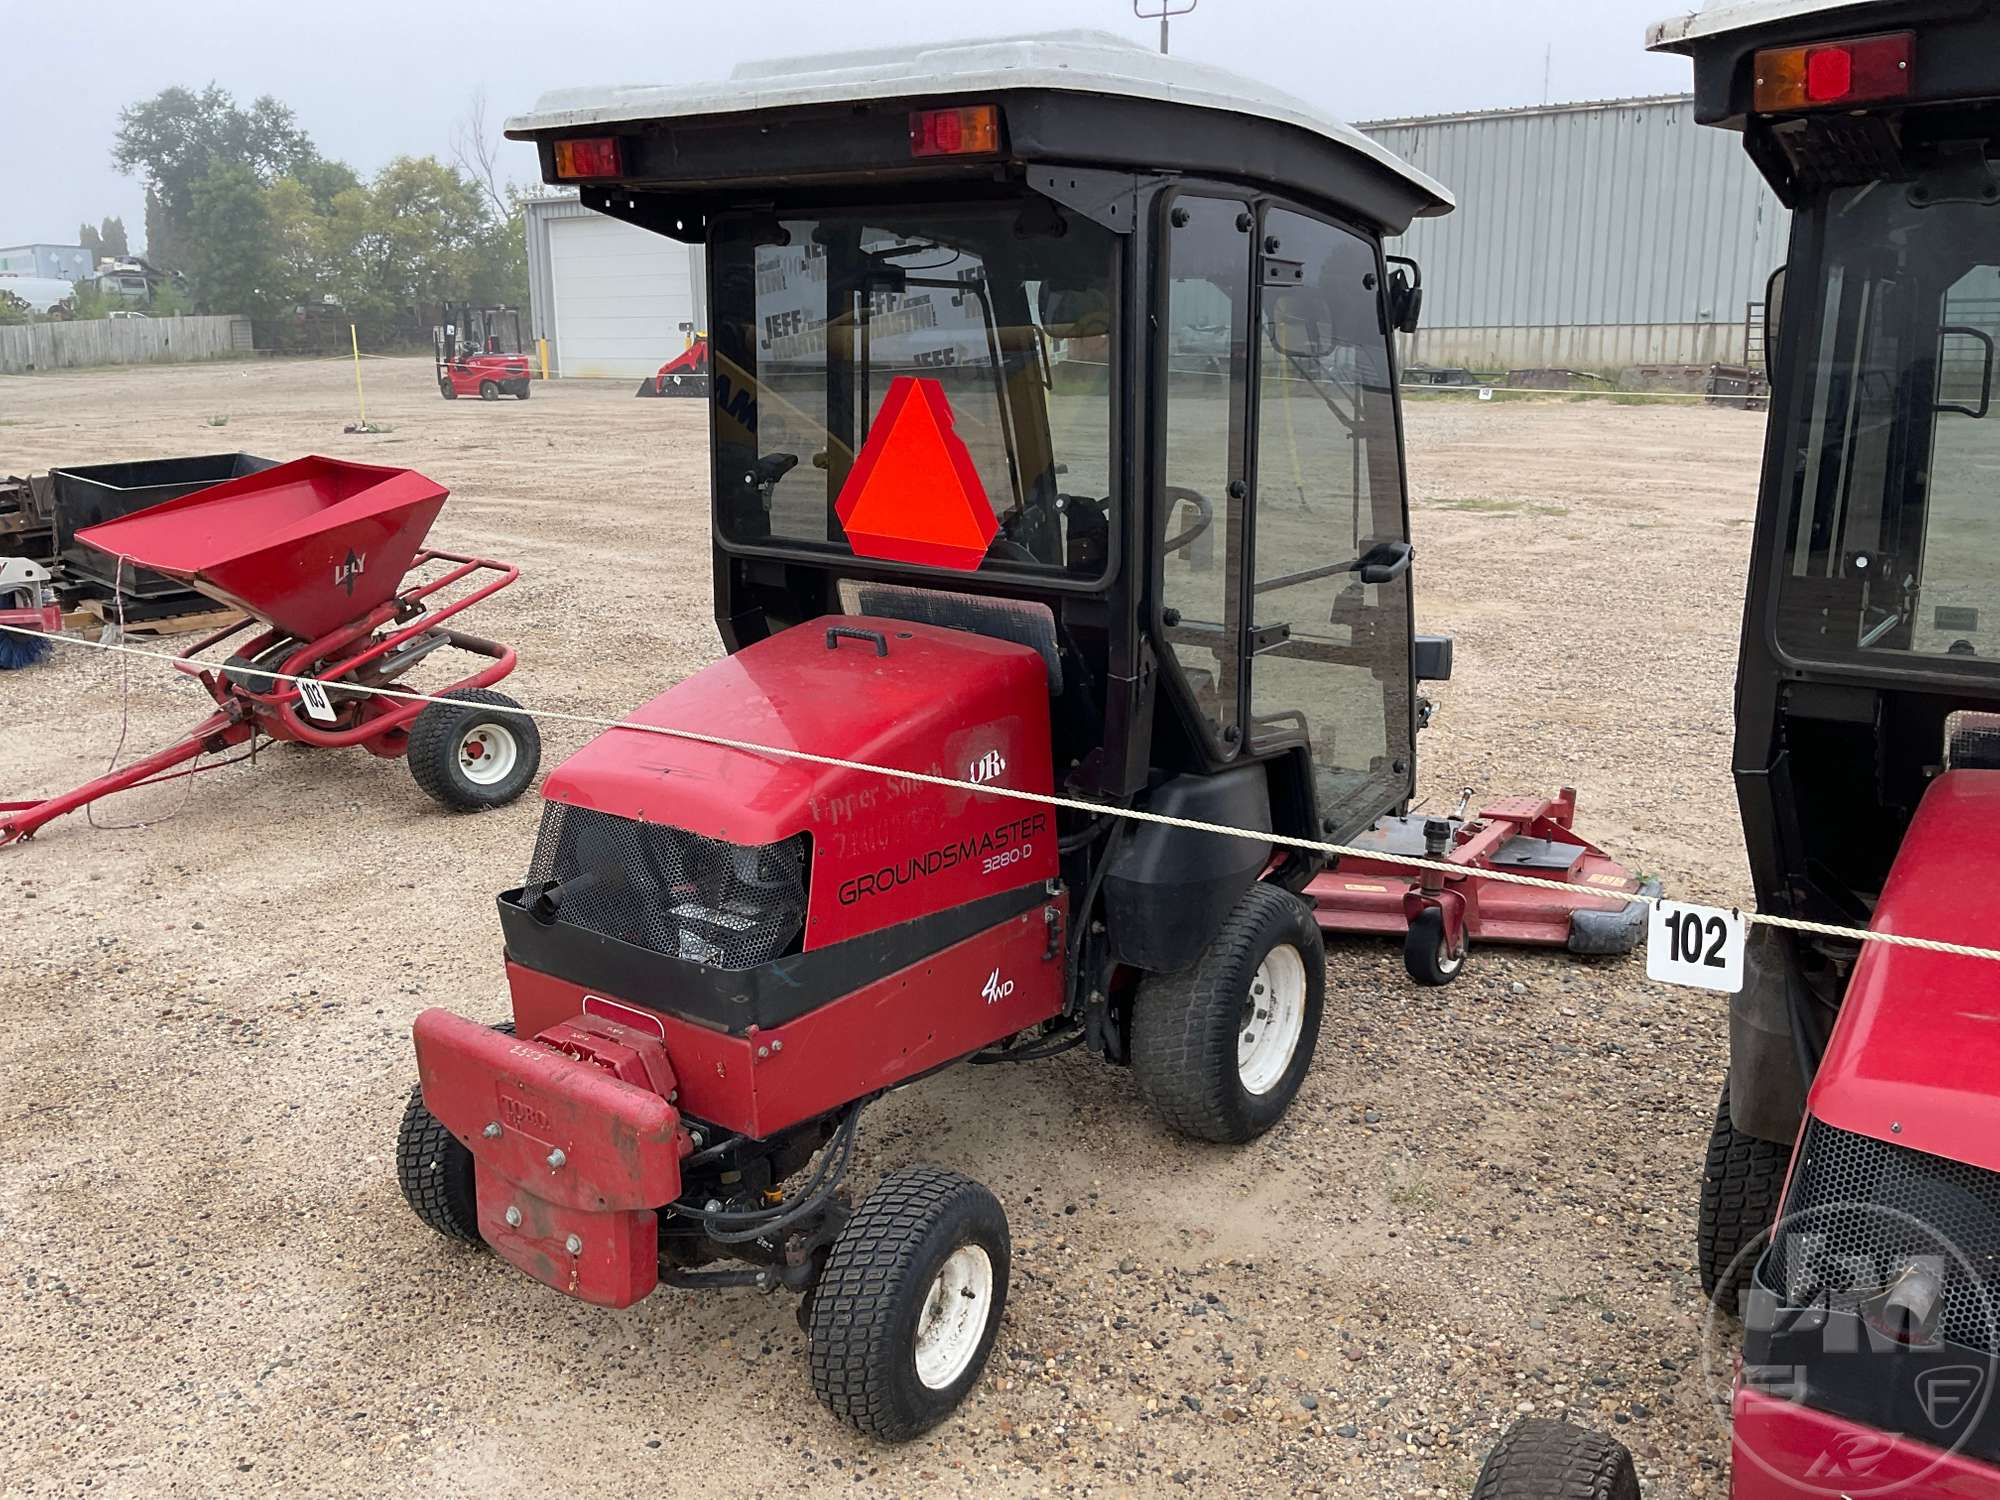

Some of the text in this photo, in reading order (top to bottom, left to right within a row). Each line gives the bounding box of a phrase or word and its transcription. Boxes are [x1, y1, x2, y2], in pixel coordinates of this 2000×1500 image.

[761, 309, 801, 350] JEFF
[335, 552, 366, 585] LELY
[301, 682, 326, 709] 103
[838, 813, 1046, 905] GROUNDSMASTER
[1665, 910, 1727, 968] 102
[981, 967, 1014, 1005] 4WD
